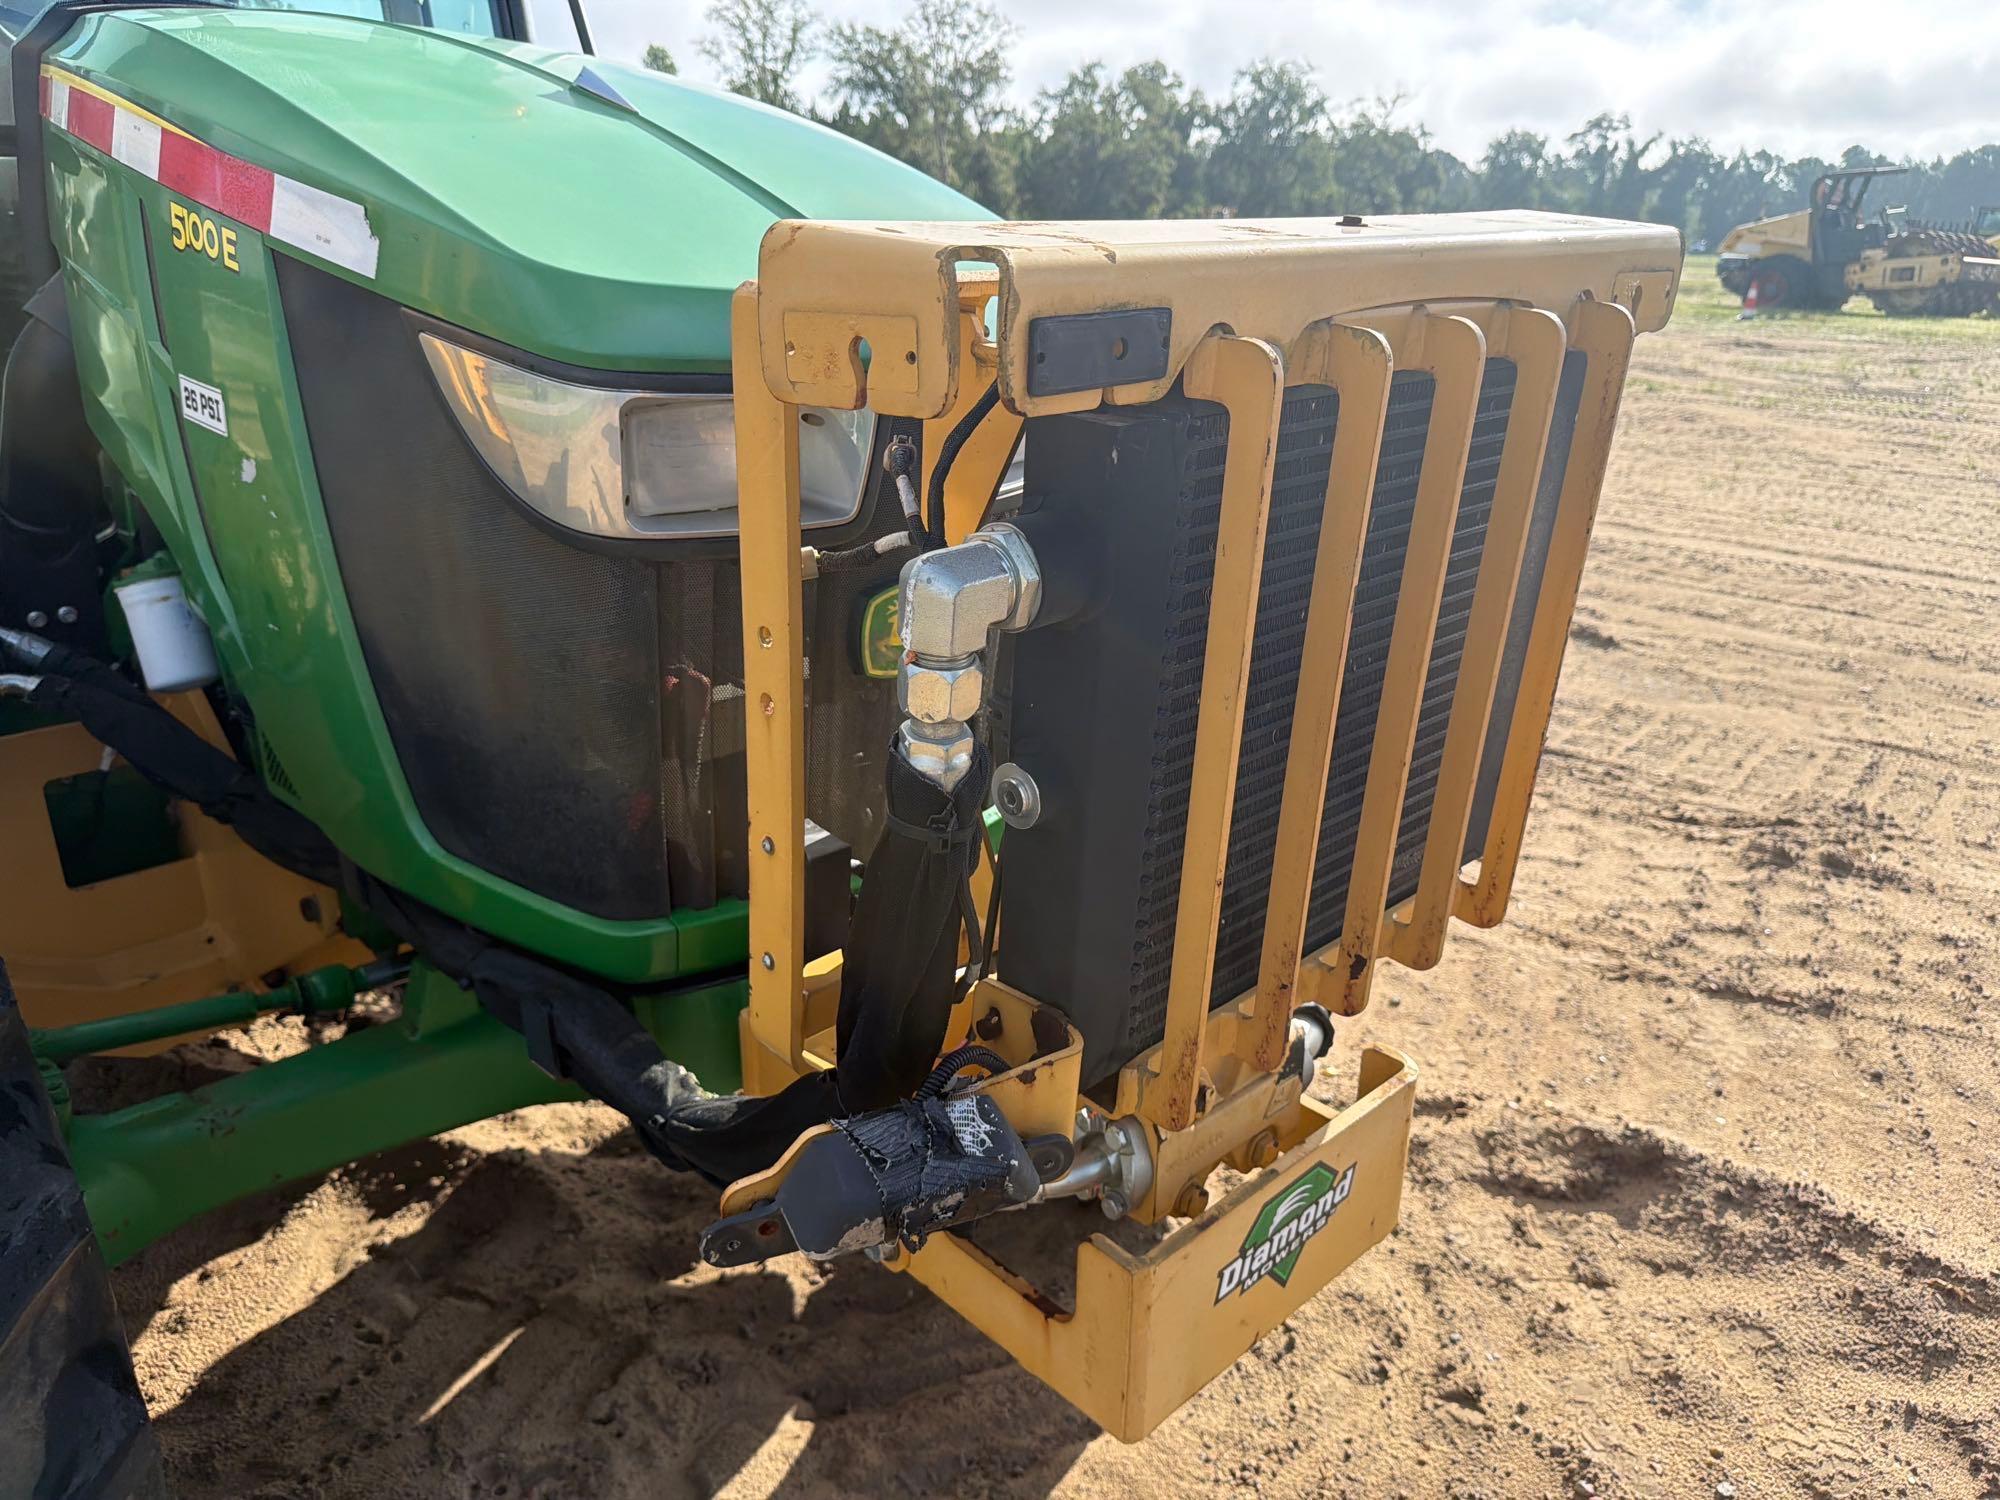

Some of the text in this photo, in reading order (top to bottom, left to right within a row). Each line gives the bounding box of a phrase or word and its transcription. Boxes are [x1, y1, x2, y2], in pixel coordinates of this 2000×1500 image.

[183, 386, 222, 423] 26 PSI
[1217, 1166, 1356, 1300] Diamond
